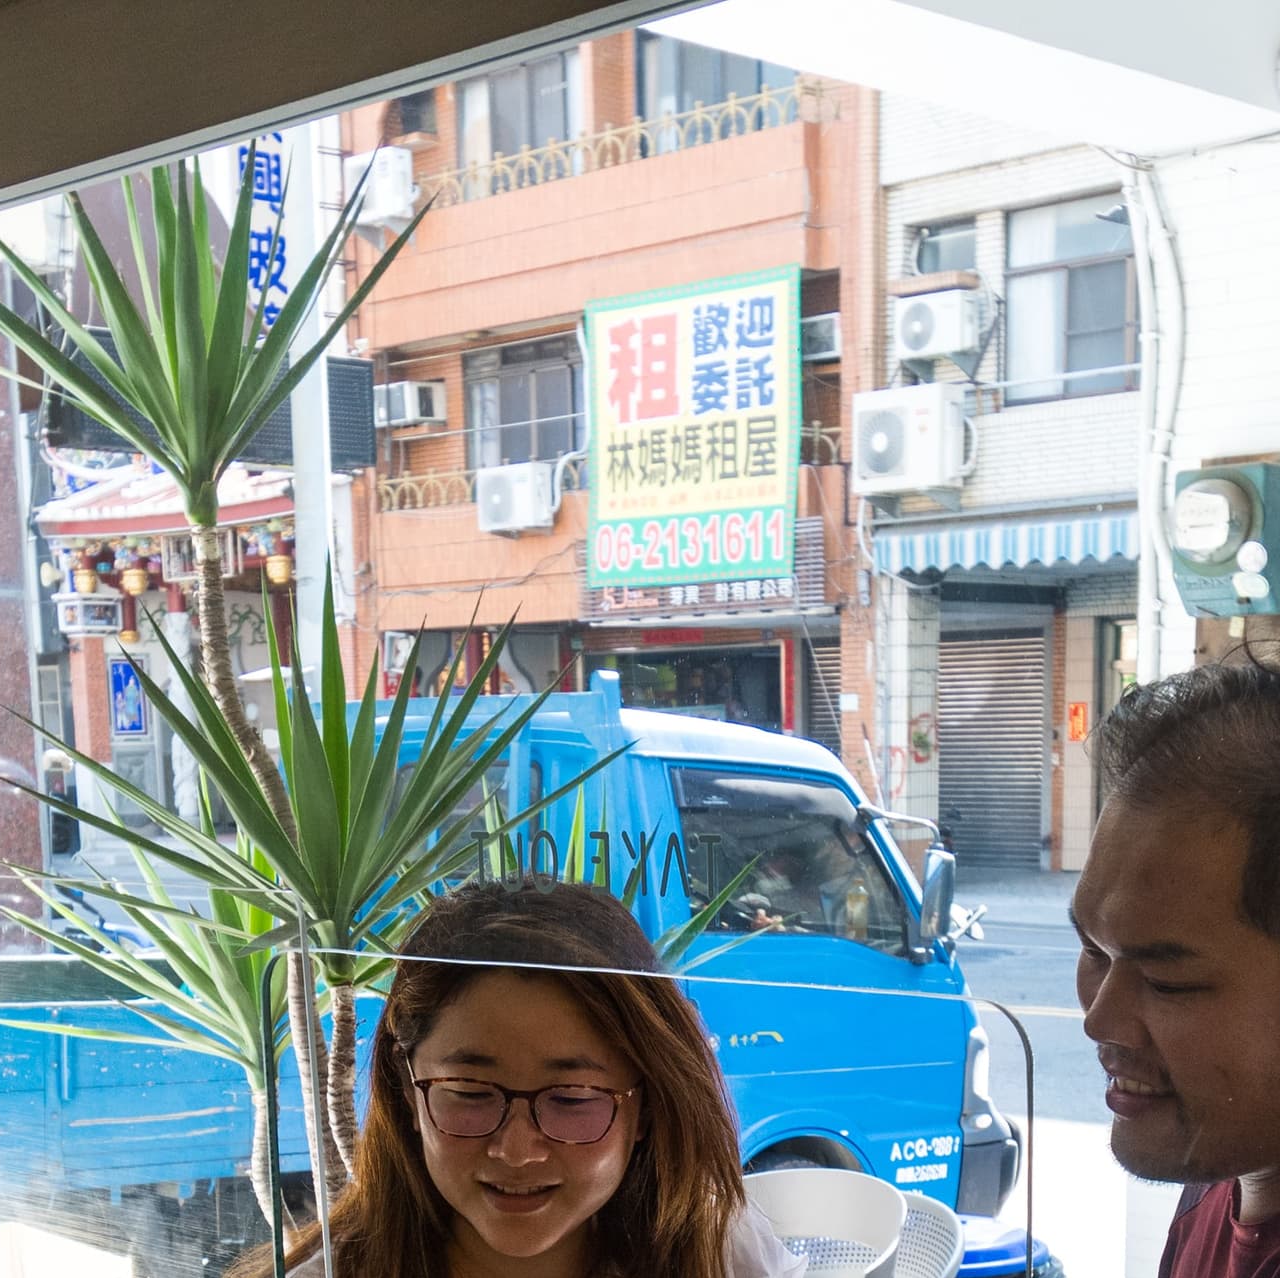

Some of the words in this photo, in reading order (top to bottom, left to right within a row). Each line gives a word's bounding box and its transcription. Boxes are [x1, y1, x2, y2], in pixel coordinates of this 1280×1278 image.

[693, 296, 774, 358] 歡迎
[608, 313, 679, 423] 租
[691, 354, 774, 415] 委託
[607, 415, 777, 493] 林媽媽租屋
[596, 509, 785, 573] 06-2131611
